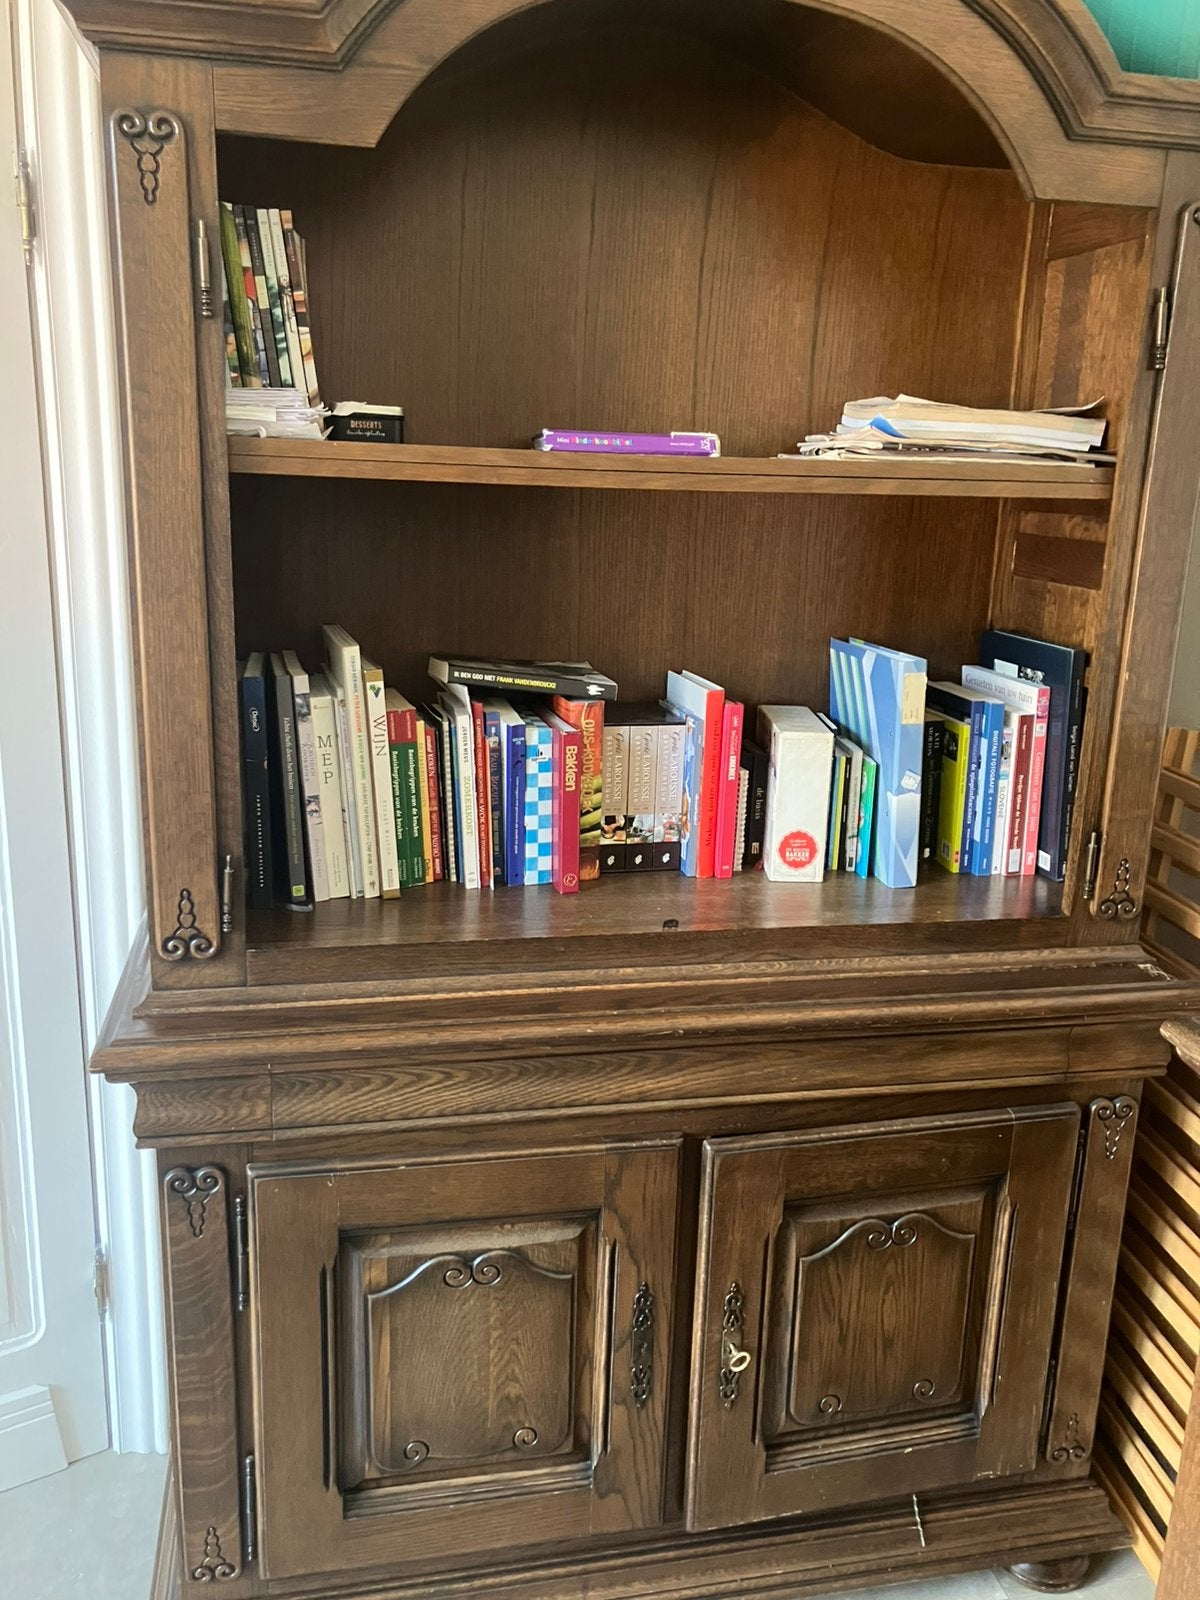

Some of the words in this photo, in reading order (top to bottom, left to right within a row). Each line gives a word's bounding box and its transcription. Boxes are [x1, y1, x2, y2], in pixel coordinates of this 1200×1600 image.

[349, 419, 382, 430] DESSERTS
[472, 673, 484, 681] GOD
[484, 674, 496, 682] NIET
[496, 675, 514, 684] FRANK
[965, 673, 993, 691] Genieten
[994, 685, 1006, 697] van
[1018, 691, 1033, 704] tuin
[373, 714, 386, 757] WIJN
[991, 730, 999, 756] DIGITALE
[408, 748, 417, 794] Basisbegrippen
[427, 753, 436, 777] KOKEN
[490, 752, 500, 773] PAUL
[565, 745, 578, 792] Bakken
[605, 735, 613, 804] gastronomique
[613, 755, 623, 803] LAROUSSE
[633, 735, 642, 803] gastronomique
[641, 754, 651, 803] LAROUSSE
[660, 734, 669, 802] gastronomique
[669, 753, 679, 801] LAROUSSE
[988, 758, 997, 795] FOTOGRAFIE
[1034, 752, 1042, 786] Genieten
[391, 750, 401, 796] Basisbegrippen
[397, 818, 405, 840] keuken
[464, 776, 473, 837] ZOMERKOST
[708, 788, 716, 812] keuken
[755, 799, 764, 820] basis
[757, 787, 765, 798] de
[1031, 802, 1037, 815] uw
[1029, 816, 1038, 832] tuin
